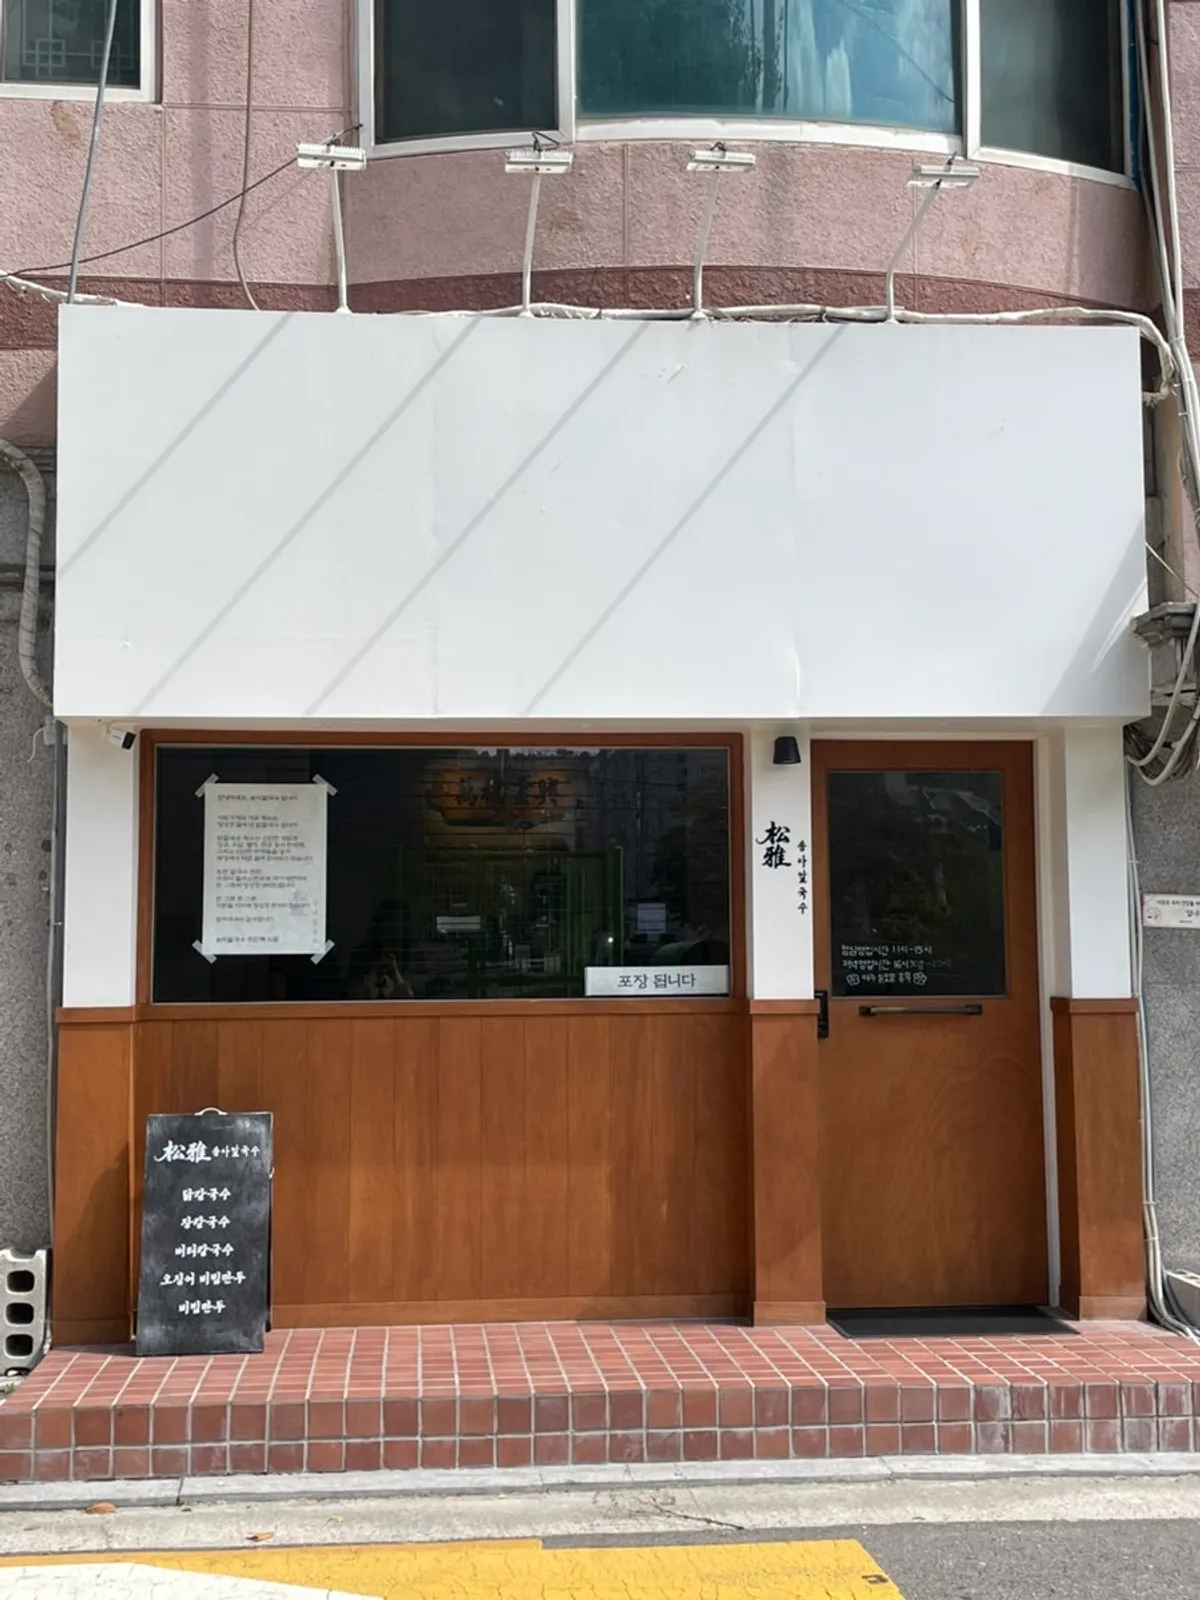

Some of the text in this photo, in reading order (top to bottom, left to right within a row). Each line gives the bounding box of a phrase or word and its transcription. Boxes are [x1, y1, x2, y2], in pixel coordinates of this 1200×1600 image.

[755, 820, 792, 870] 松雅
[797, 839, 809, 915] 송아칼국수
[618, 972, 697, 989] 포장 됩니다
[153, 1140, 212, 1164] 松雅
[159, 1270, 247, 1287] 오징어 비빔만두
[178, 1299, 227, 1315] 비빔만두
